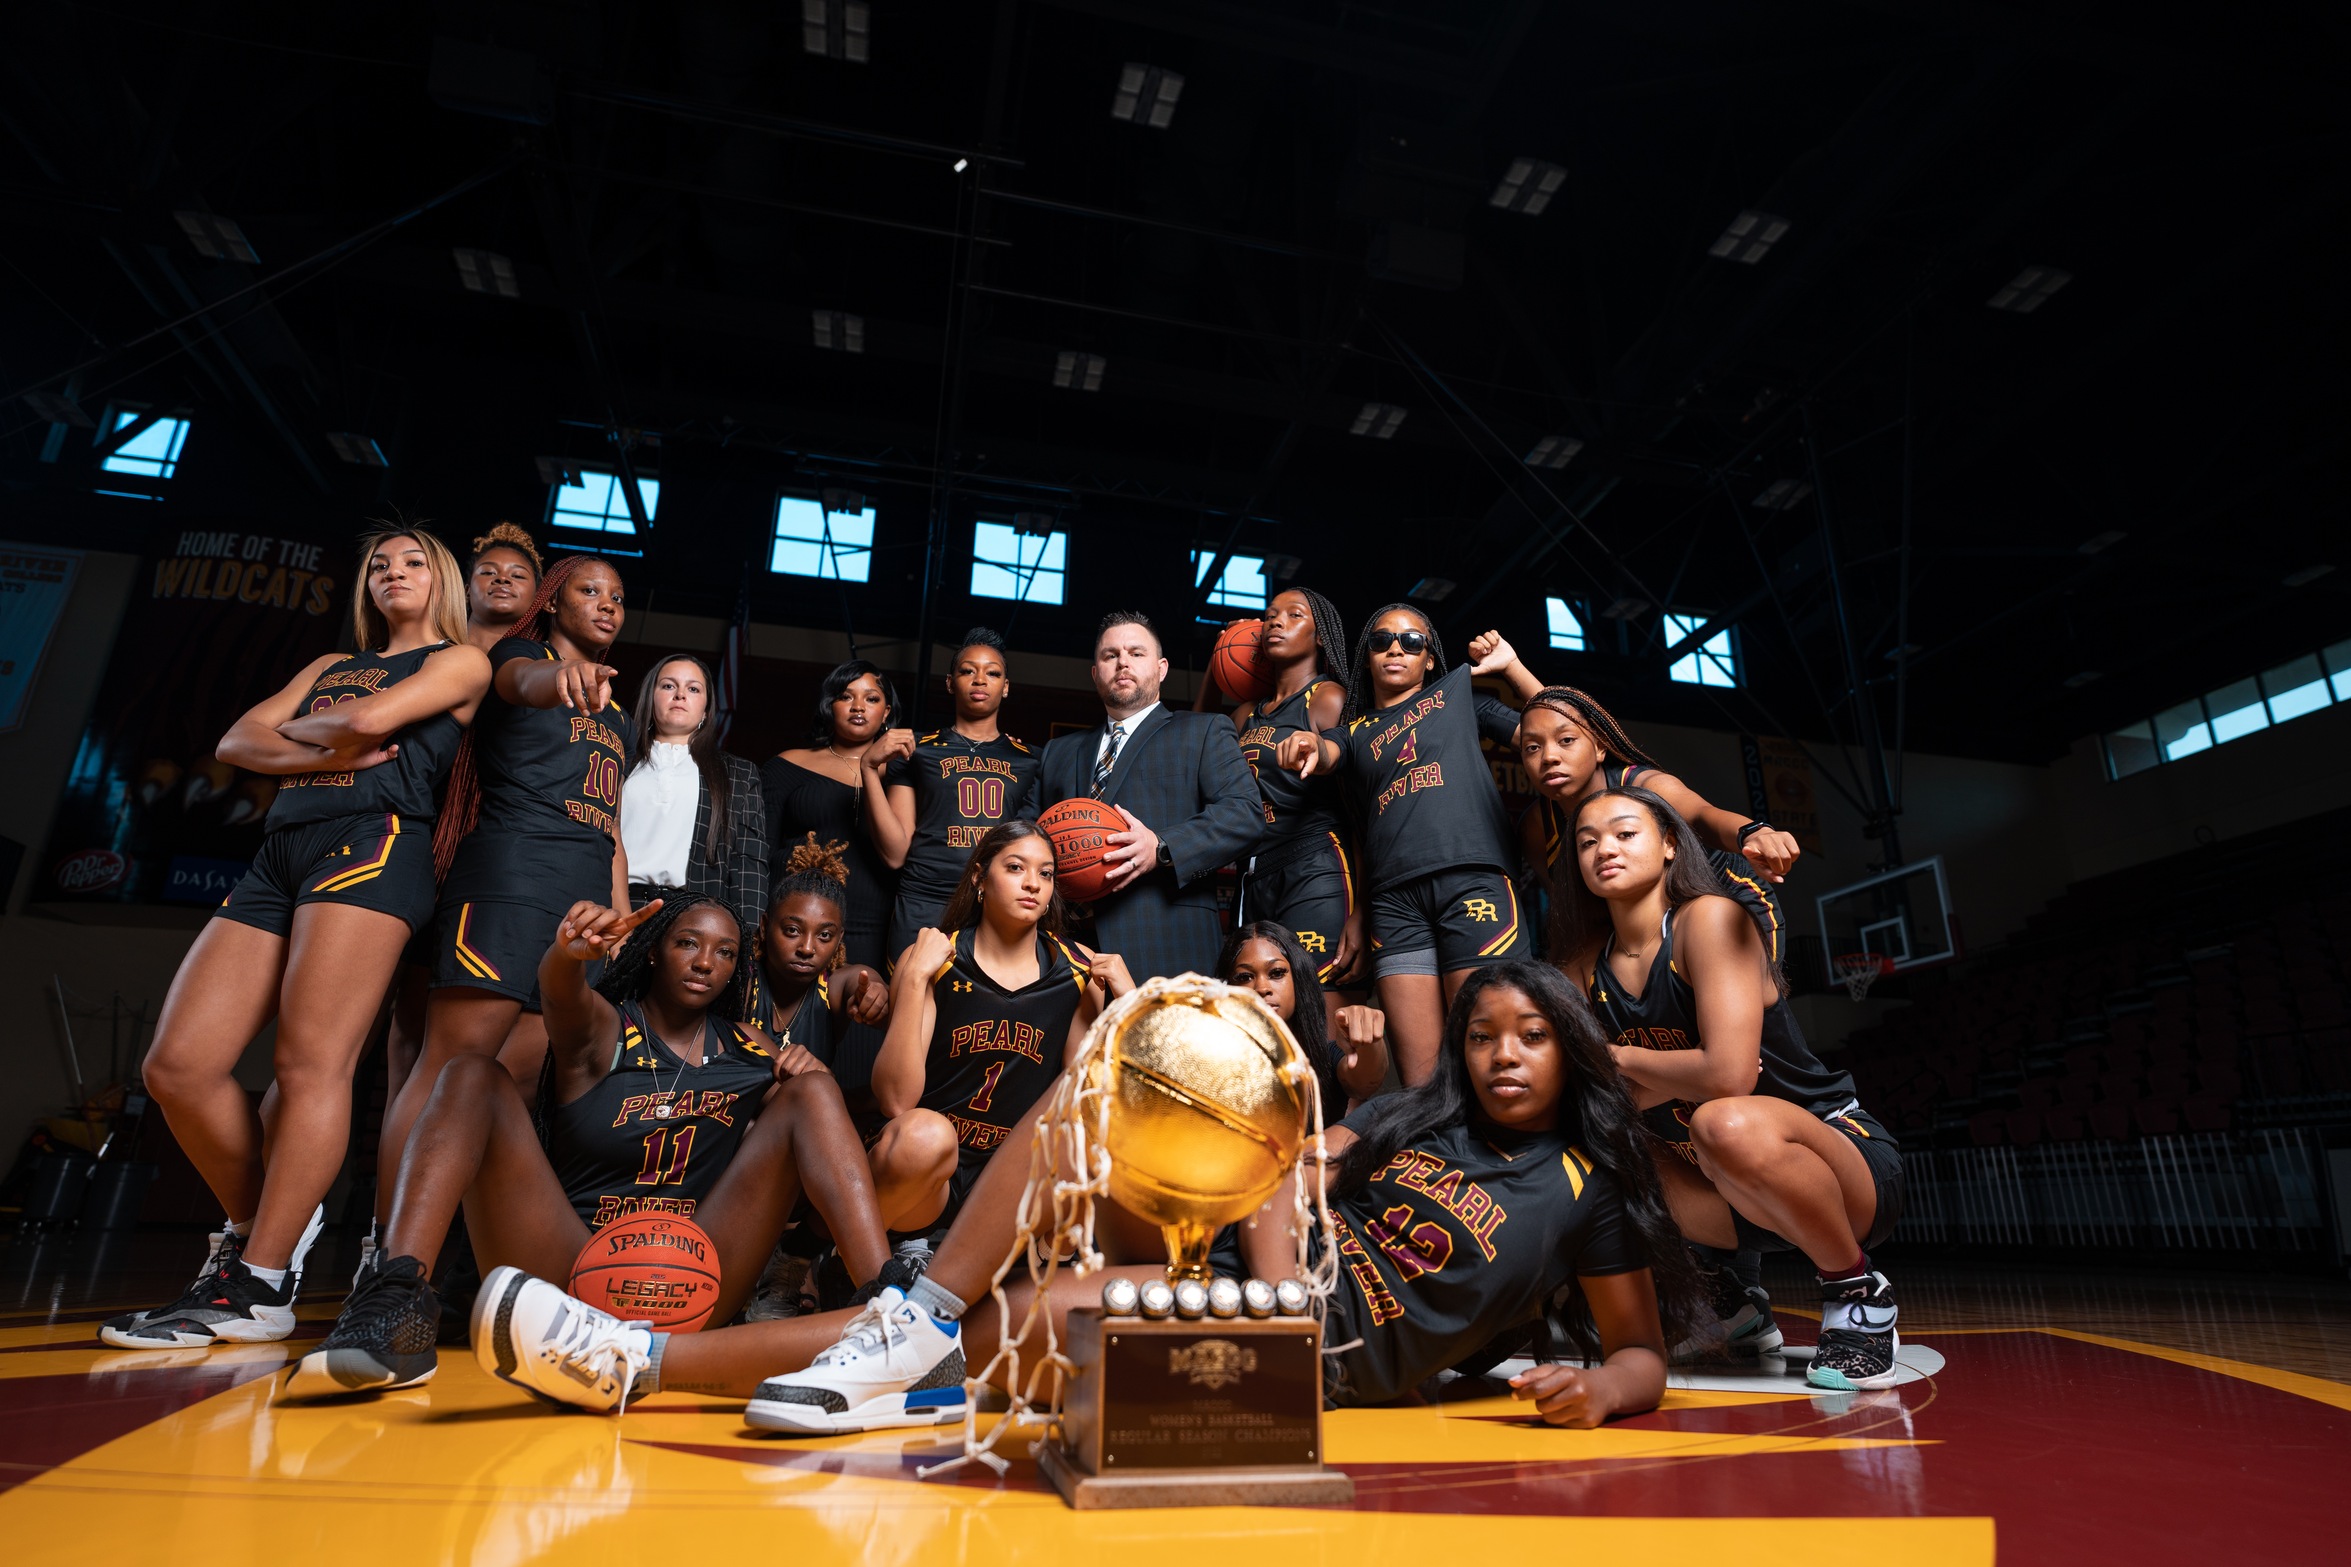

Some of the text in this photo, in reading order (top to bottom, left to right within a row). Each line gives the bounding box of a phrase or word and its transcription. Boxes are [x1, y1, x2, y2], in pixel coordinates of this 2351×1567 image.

[176, 531, 324, 572] HOME OF THE
[153, 558, 335, 616] WILDCATS
[570, 716, 626, 761] PEAR
[1239, 726, 1277, 751] EARL
[1370, 690, 1445, 761] PEARL
[584, 750, 618, 807] 10
[940, 755, 1018, 783] PEARL
[957, 777, 1005, 818] 00
[565, 800, 615, 836] RIVE
[1039, 809, 1101, 829] PALDING
[947, 826, 993, 847] RIV
[1059, 835, 1103, 855] 1000
[63, 859, 119, 888] Pepper
[83, 855, 107, 871] Dr
[173, 869, 240, 892] DASAN
[949, 1019, 1045, 1065] PEARL
[1616, 1027, 1696, 1050] EARL
[968, 1061, 1005, 1112] 1
[612, 1090, 739, 1128] PEARL
[635, 1125, 697, 1185] 11
[1369, 1149, 1507, 1263] PEARL
[607, 1232, 706, 1264] SPALDING
[606, 1278, 698, 1298] LEGACY
[633, 1299, 688, 1310] 1000
[1208, 1413, 1274, 1427] BASKETBALL
[1109, 1427, 1312, 1445] REGULAR SEASON CHAMPIONS
